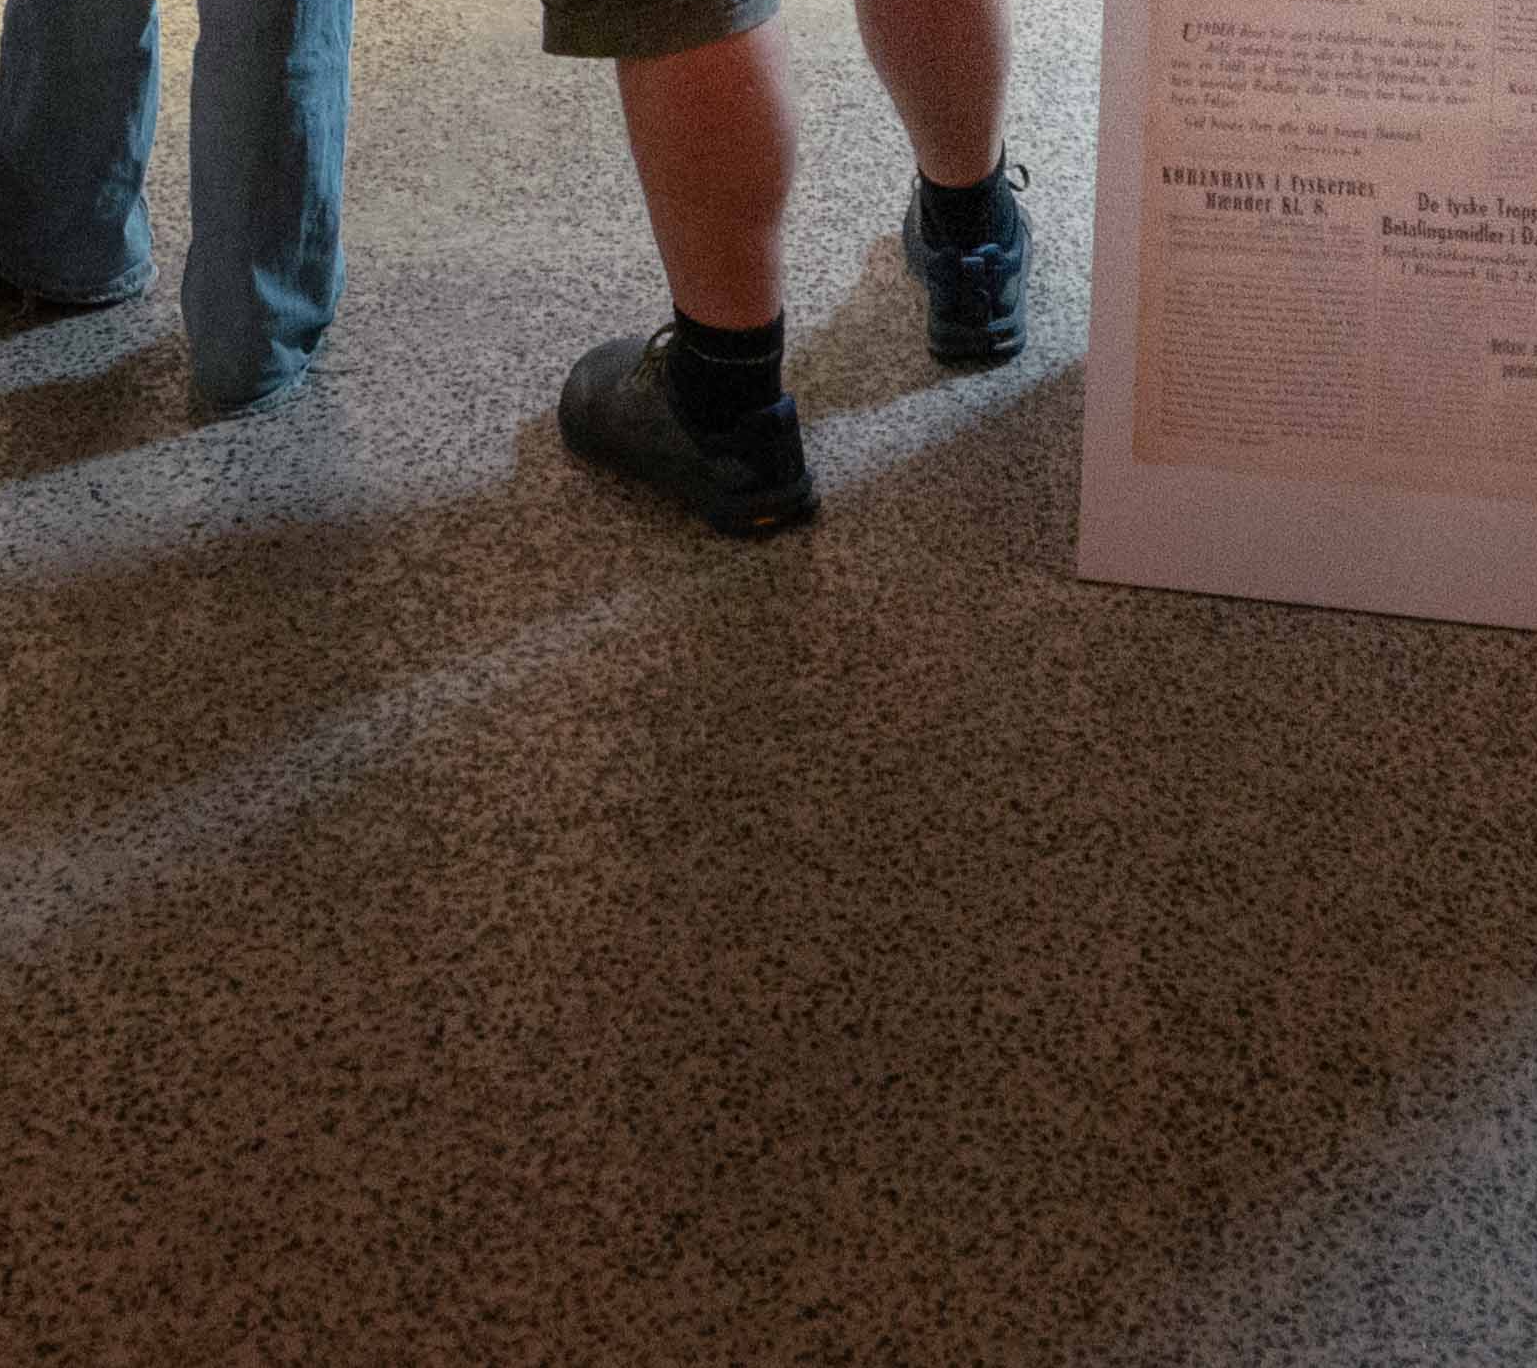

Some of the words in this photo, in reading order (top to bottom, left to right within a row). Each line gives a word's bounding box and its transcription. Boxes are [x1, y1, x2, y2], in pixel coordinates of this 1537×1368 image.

[1161, 166, 1266, 192] KØBENHAVN
[1417, 192, 1440, 213] De
[1447, 196, 1489, 218] tyske
[1381, 216, 1505, 246] Betalingsmidler
